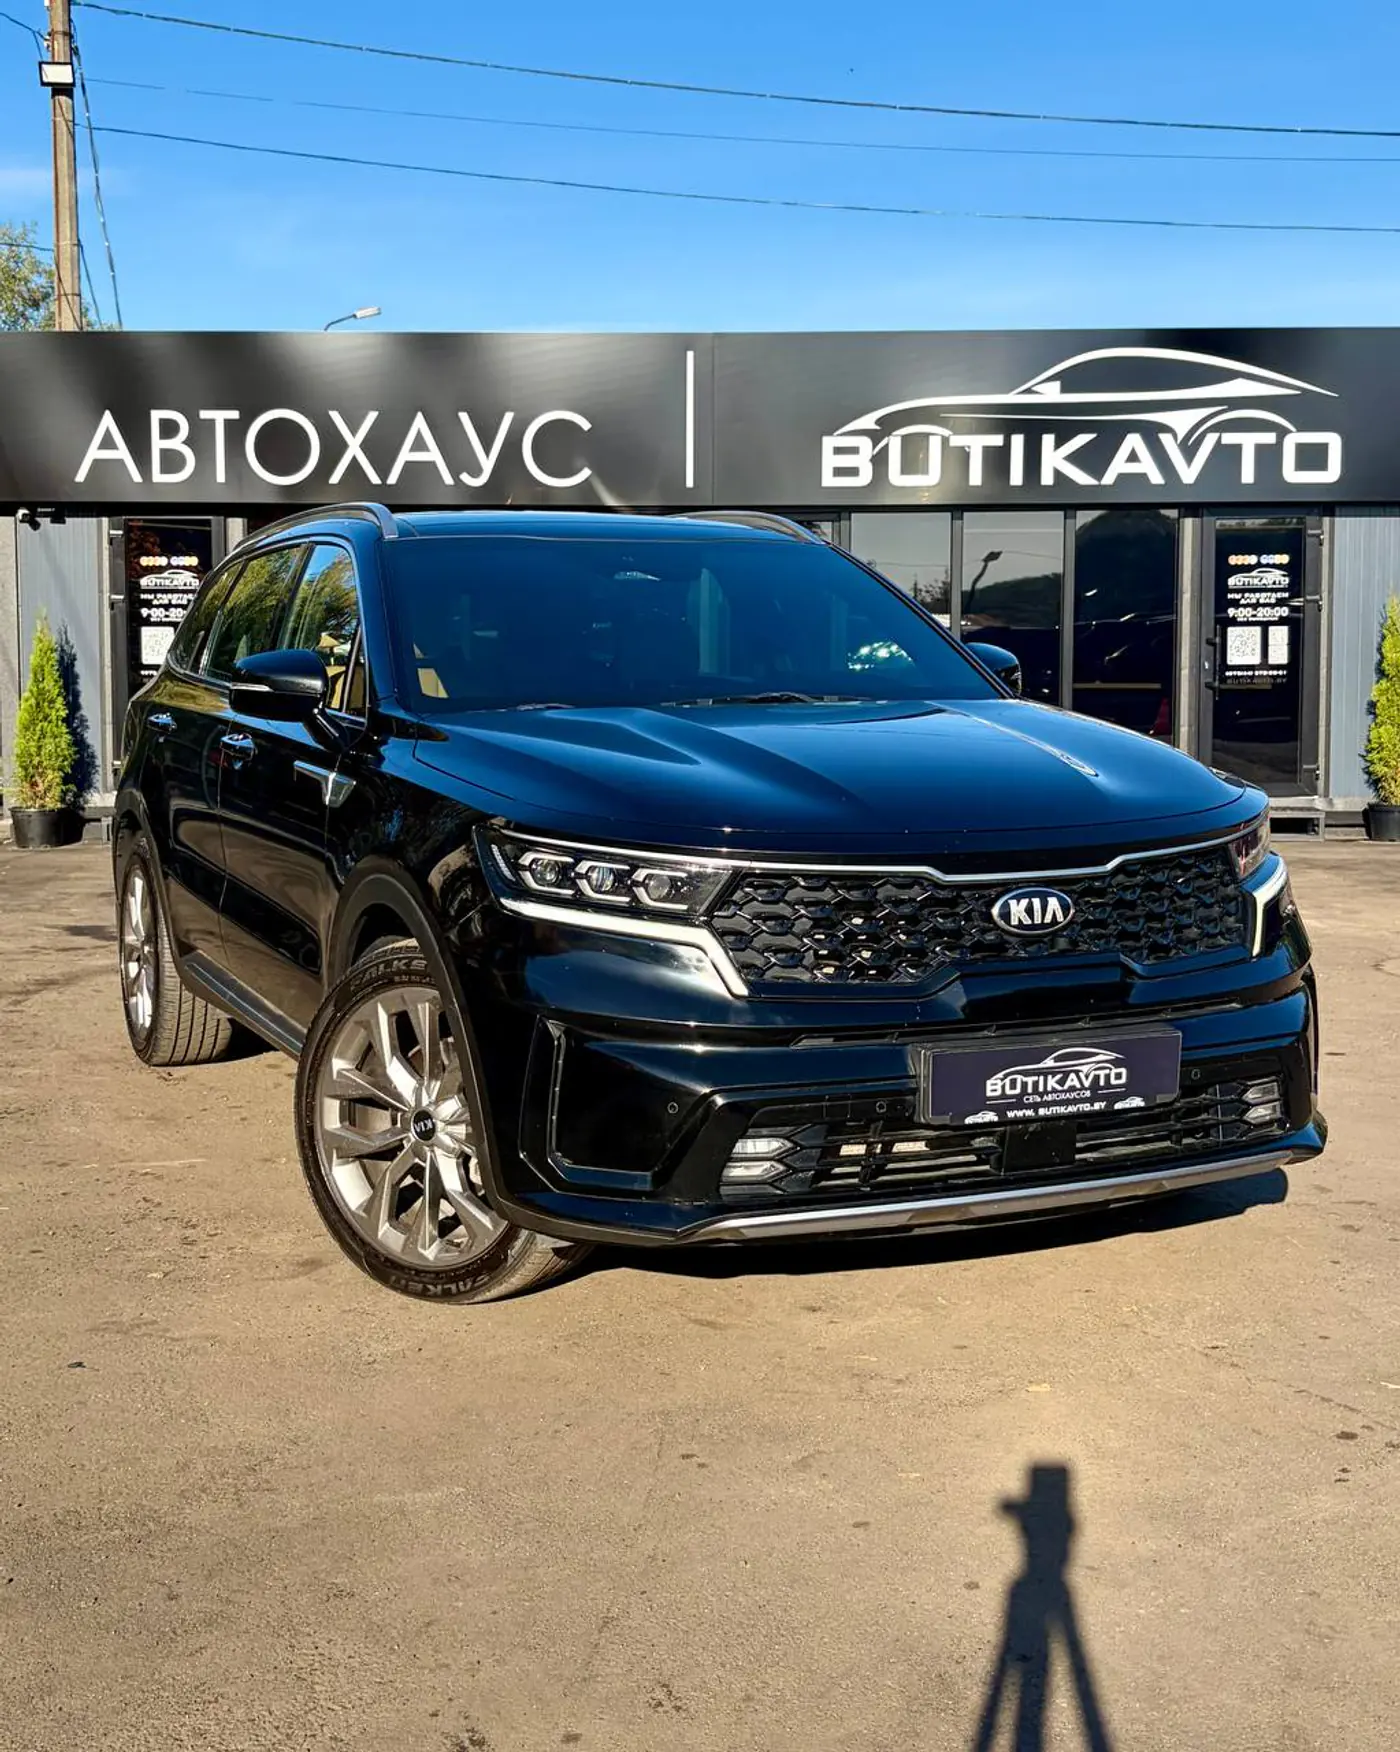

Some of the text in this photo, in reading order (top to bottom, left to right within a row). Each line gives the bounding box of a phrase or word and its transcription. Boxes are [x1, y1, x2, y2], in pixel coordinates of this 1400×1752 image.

[74, 407, 593, 488] АВТОХАУС
[821, 431, 1342, 488] BUTIKAVTO
[141, 607, 187, 619] 9:00-20:
[1007, 896, 1065, 926] KIA
[985, 1067, 1127, 1097] BUTIKAVTO
[1038, 1101, 1107, 1116] BUTIKAVTO.BY
[413, 1117, 434, 1133] KIA
